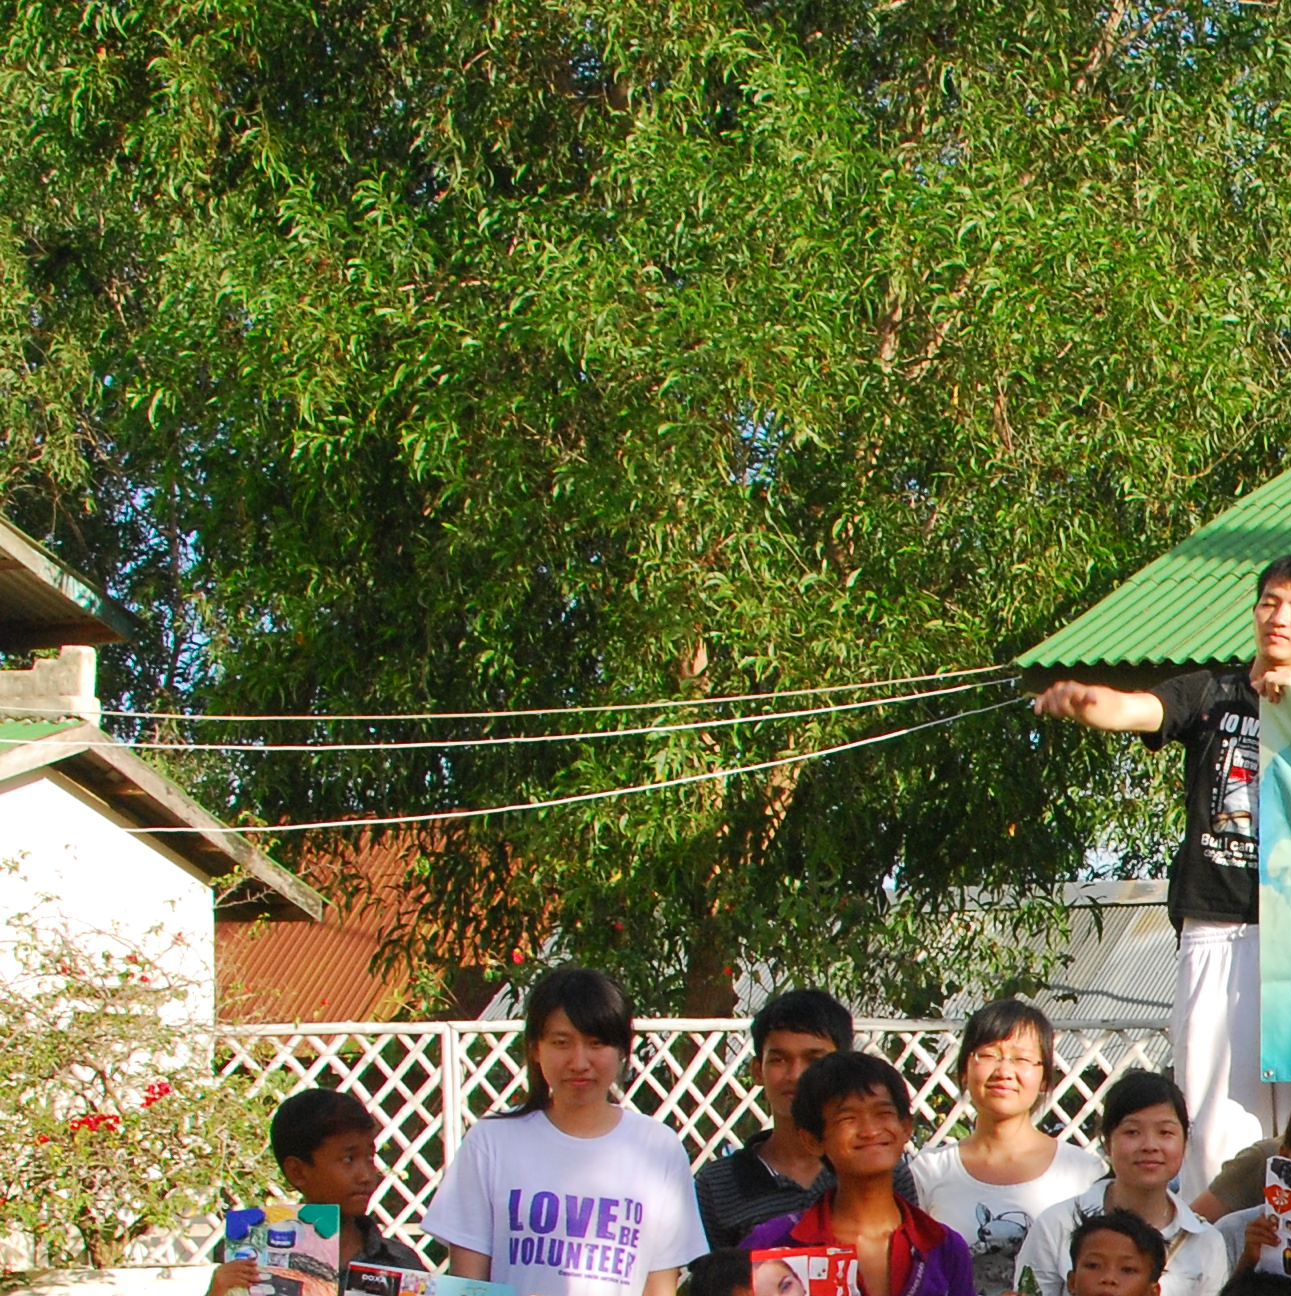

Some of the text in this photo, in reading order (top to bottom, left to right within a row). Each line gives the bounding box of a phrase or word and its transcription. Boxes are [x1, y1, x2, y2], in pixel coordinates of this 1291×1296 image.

[508, 1188, 620, 1240] LOVE
[624, 1197, 643, 1225] TO
[618, 1225, 640, 1249] BE
[508, 1235, 636, 1277] VOLUNTEER
